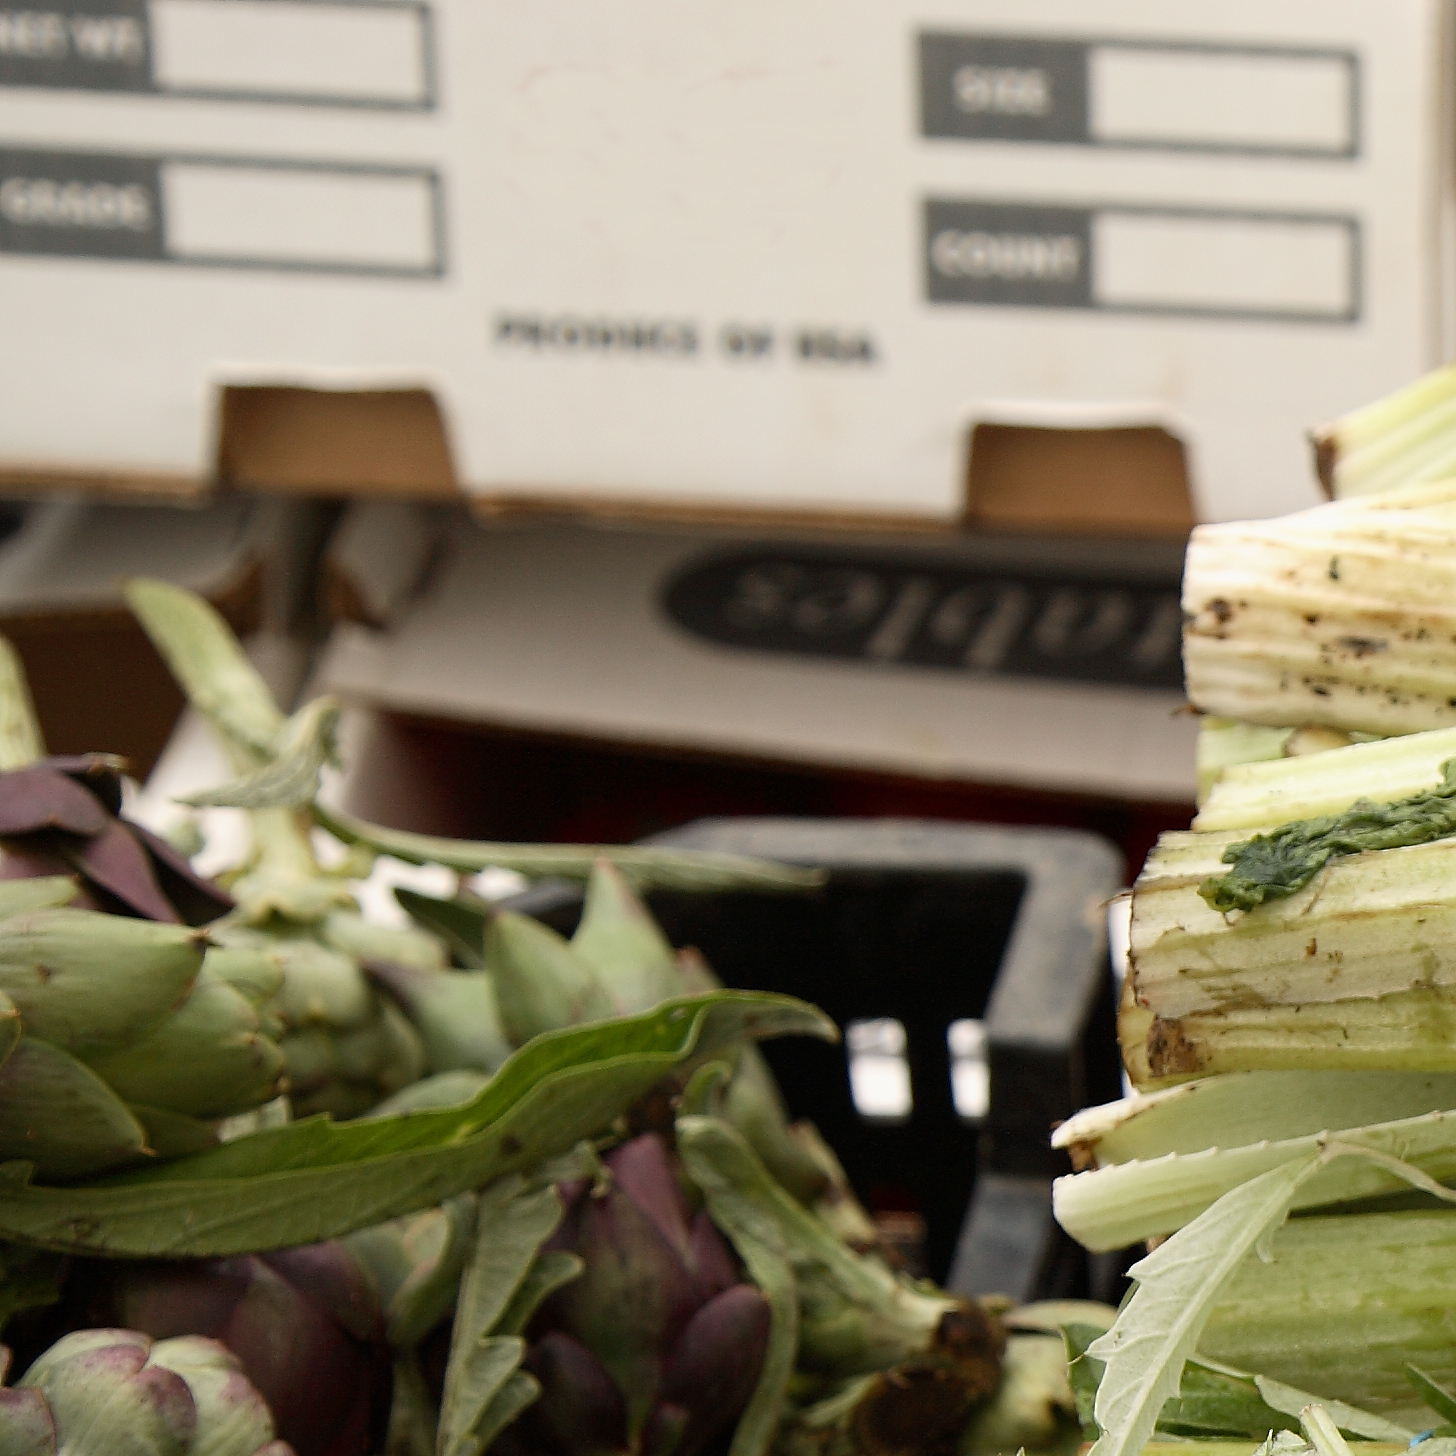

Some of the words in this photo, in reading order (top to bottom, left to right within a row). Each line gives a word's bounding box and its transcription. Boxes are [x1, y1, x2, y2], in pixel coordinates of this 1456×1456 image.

[953, 65, 1050, 116] SIZE
[0, 177, 150, 232] GRADE
[930, 229, 1080, 281] COUNT
[494, 311, 699, 354] PRODUCE
[720, 321, 773, 357] OF
[797, 326, 874, 364] USA
